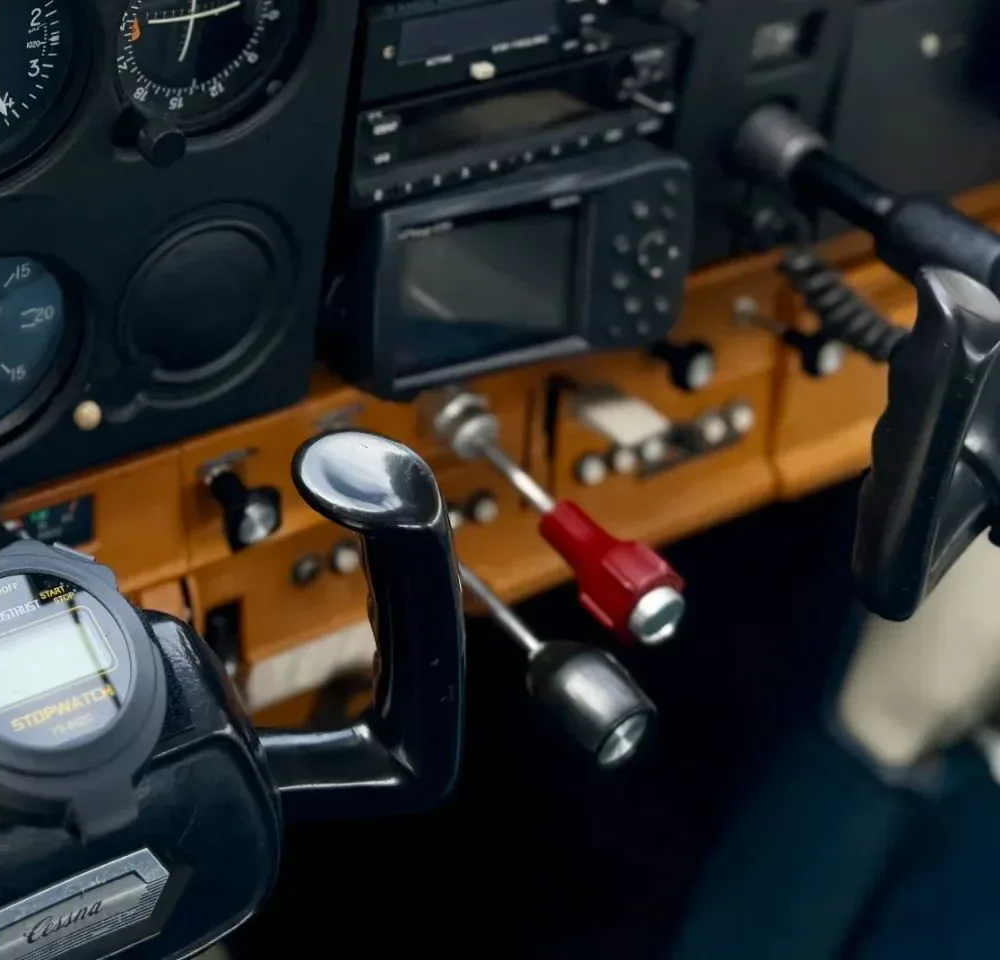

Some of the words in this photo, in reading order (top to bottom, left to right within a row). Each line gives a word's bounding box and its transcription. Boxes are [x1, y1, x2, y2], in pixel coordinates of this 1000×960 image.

[30, 8, 42, 27] 2
[28, 58, 40, 77] 3
[15, 262, 32, 280] 15
[34, 306, 54, 322] 20
[10, 365, 26, 382] 15
[40, 585, 66, 600] START
[53, 592, 75, 604] STOP
[10, 684, 115, 732] STOPWATCH
[24, 900, 103, 944] Cessna
